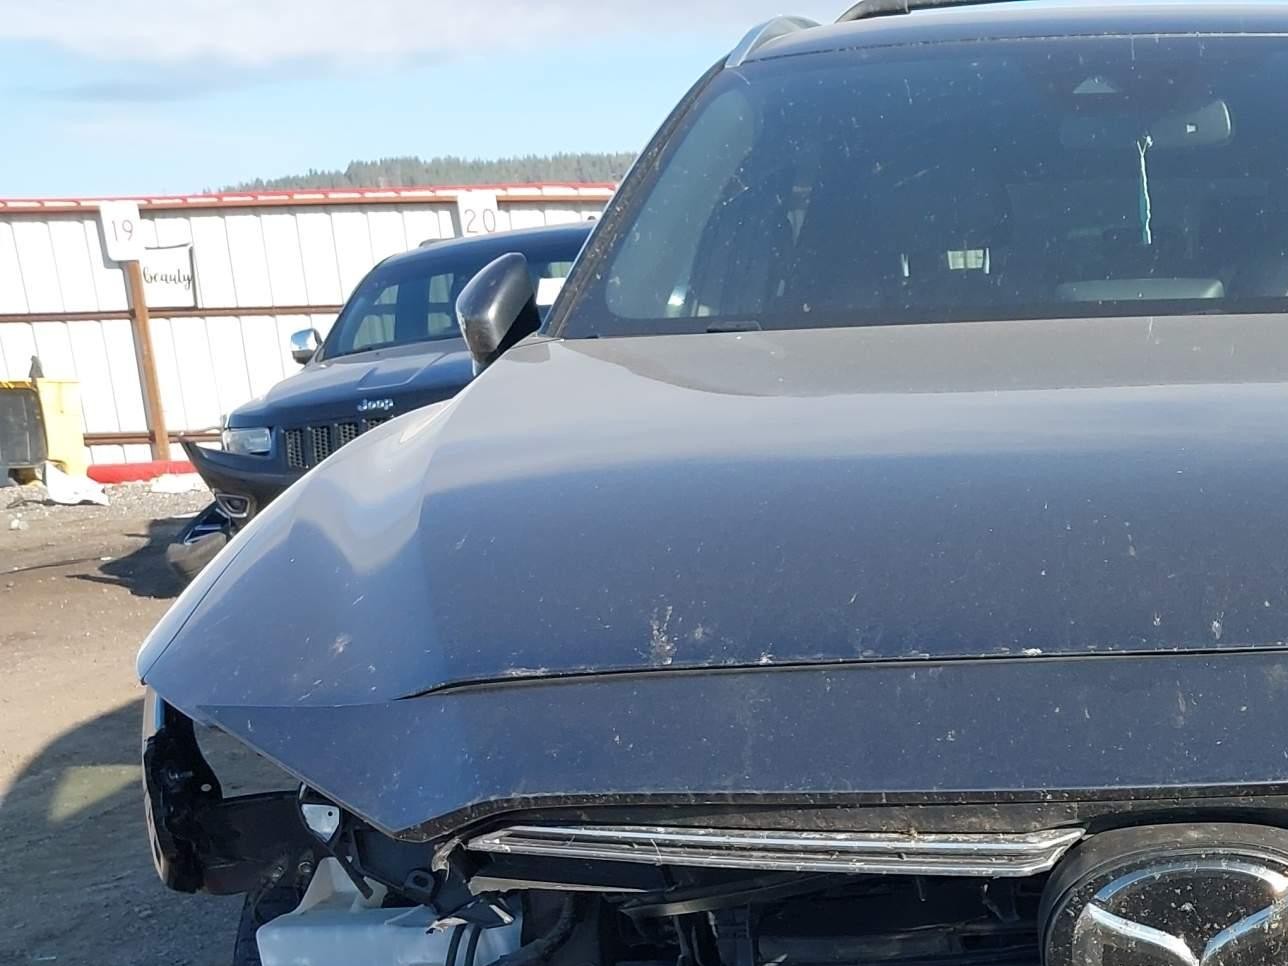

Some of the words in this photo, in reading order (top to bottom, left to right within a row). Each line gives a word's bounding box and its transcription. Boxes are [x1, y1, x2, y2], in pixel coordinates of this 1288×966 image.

[112, 219, 133, 241] 19
[464, 208, 496, 233] 20
[143, 266, 193, 291] beauty
[357, 398, 394, 412] Jeep
